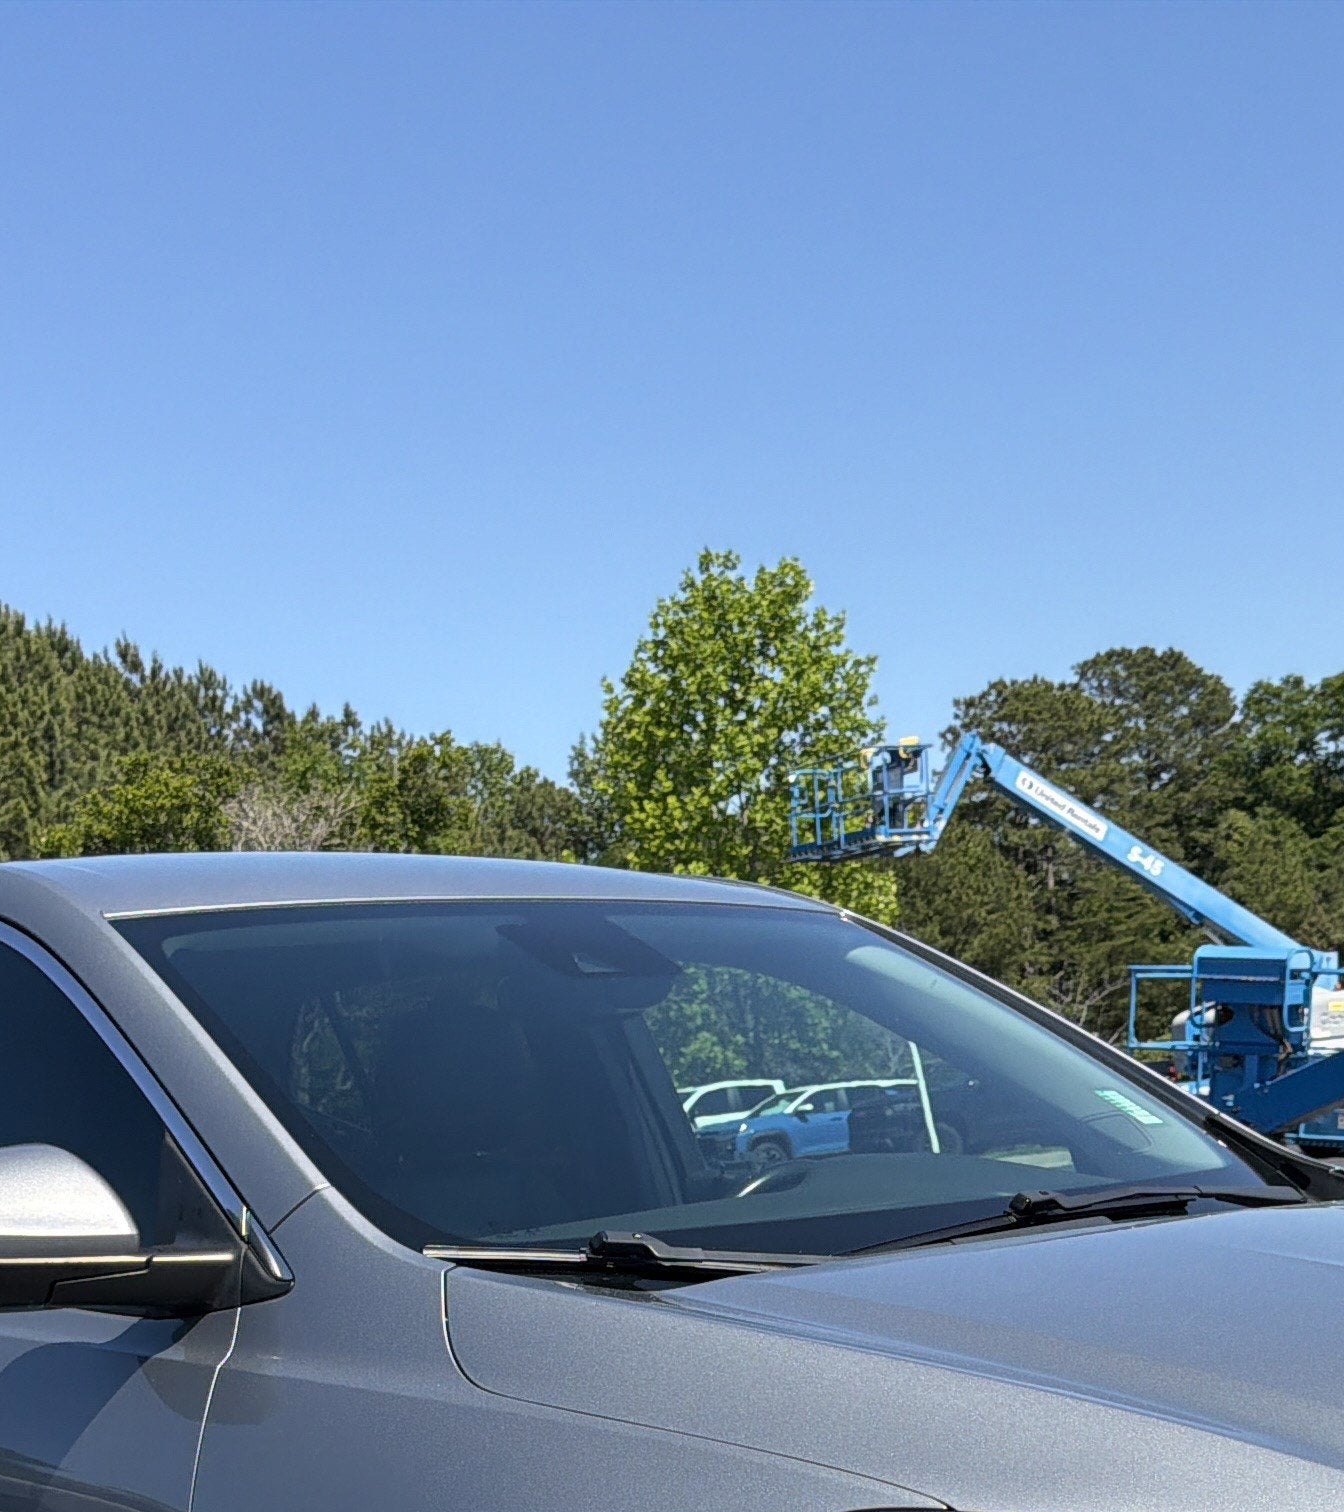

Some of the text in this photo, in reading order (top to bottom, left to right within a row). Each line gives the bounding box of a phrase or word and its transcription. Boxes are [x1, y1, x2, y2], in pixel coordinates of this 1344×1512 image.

[1034, 785, 1101, 835] United Rentals
[1127, 845, 1165, 877] S-45
